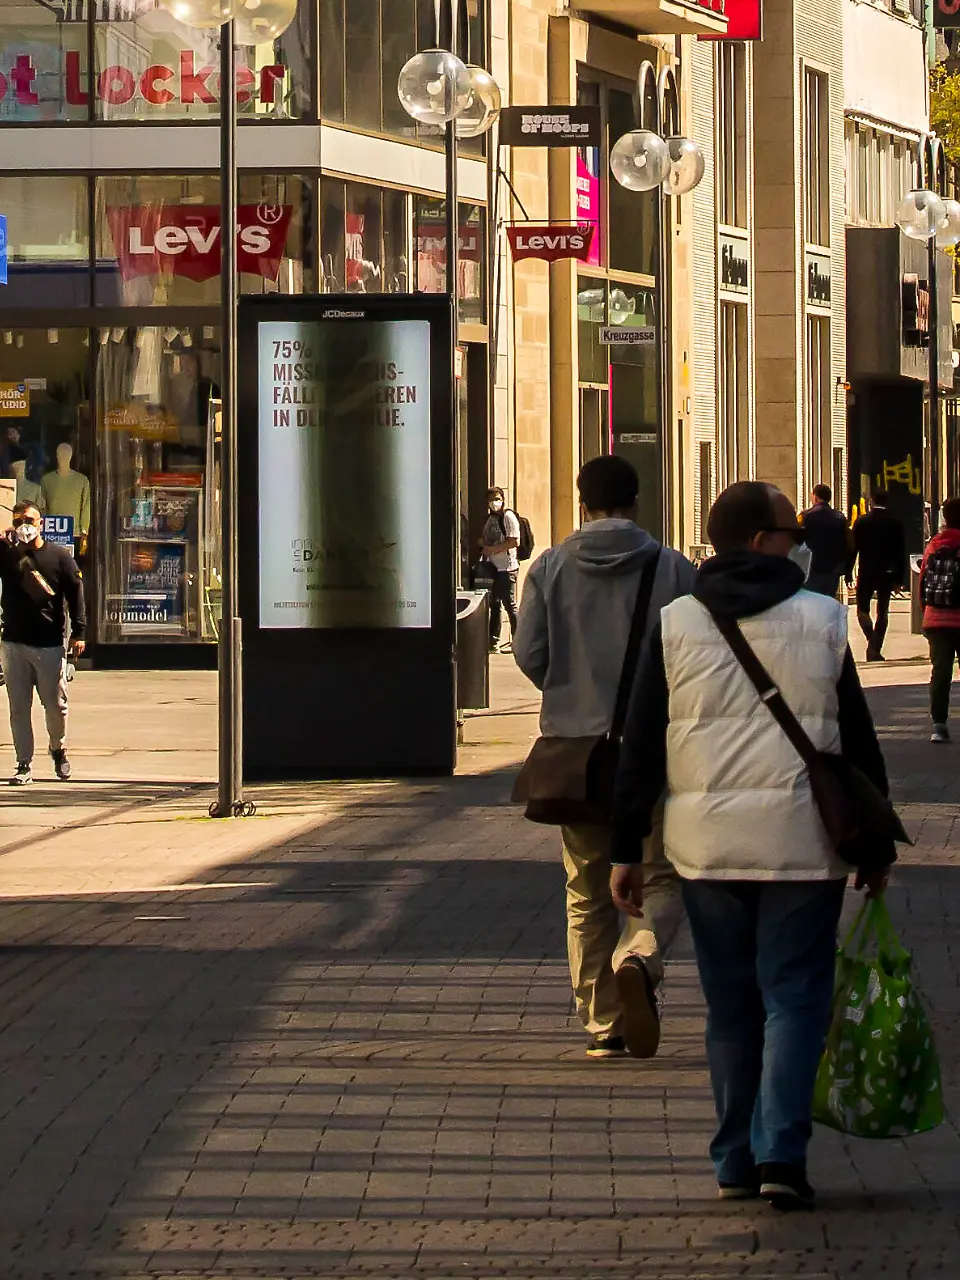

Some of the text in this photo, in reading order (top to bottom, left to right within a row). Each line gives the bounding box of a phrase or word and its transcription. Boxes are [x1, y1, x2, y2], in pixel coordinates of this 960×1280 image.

[65, 48, 285, 106] Locker
[129, 224, 271, 255] Lev's
[322, 309, 365, 318] JCDecaux
[603, 330, 655, 343] Kreuzgasse
[273, 409, 290, 427] IN
